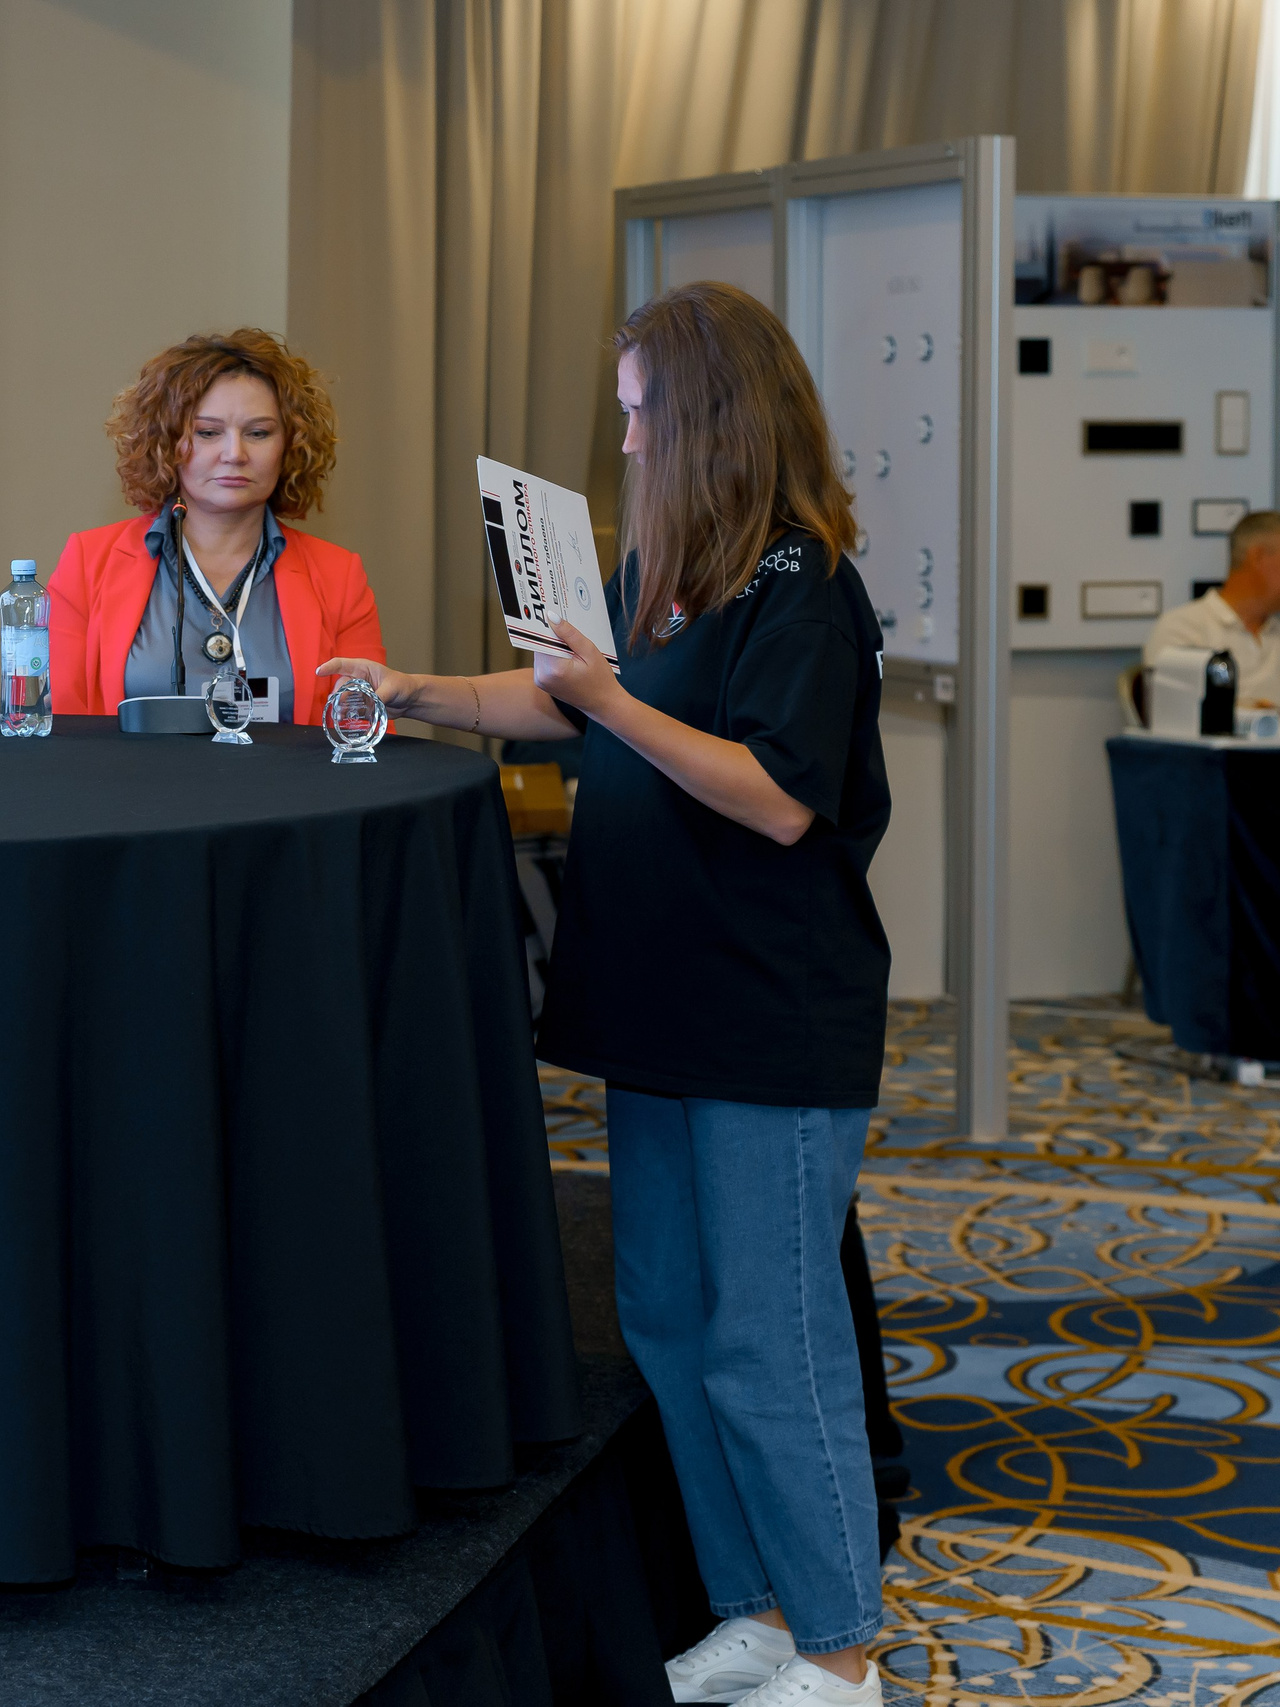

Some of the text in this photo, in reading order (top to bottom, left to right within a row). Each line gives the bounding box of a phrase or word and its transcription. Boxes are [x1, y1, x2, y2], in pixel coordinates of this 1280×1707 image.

[513, 480, 549, 628] ДИПЛОМ
[523, 483, 546, 603] ПОЧЕТНОГО СПИКЕРА
